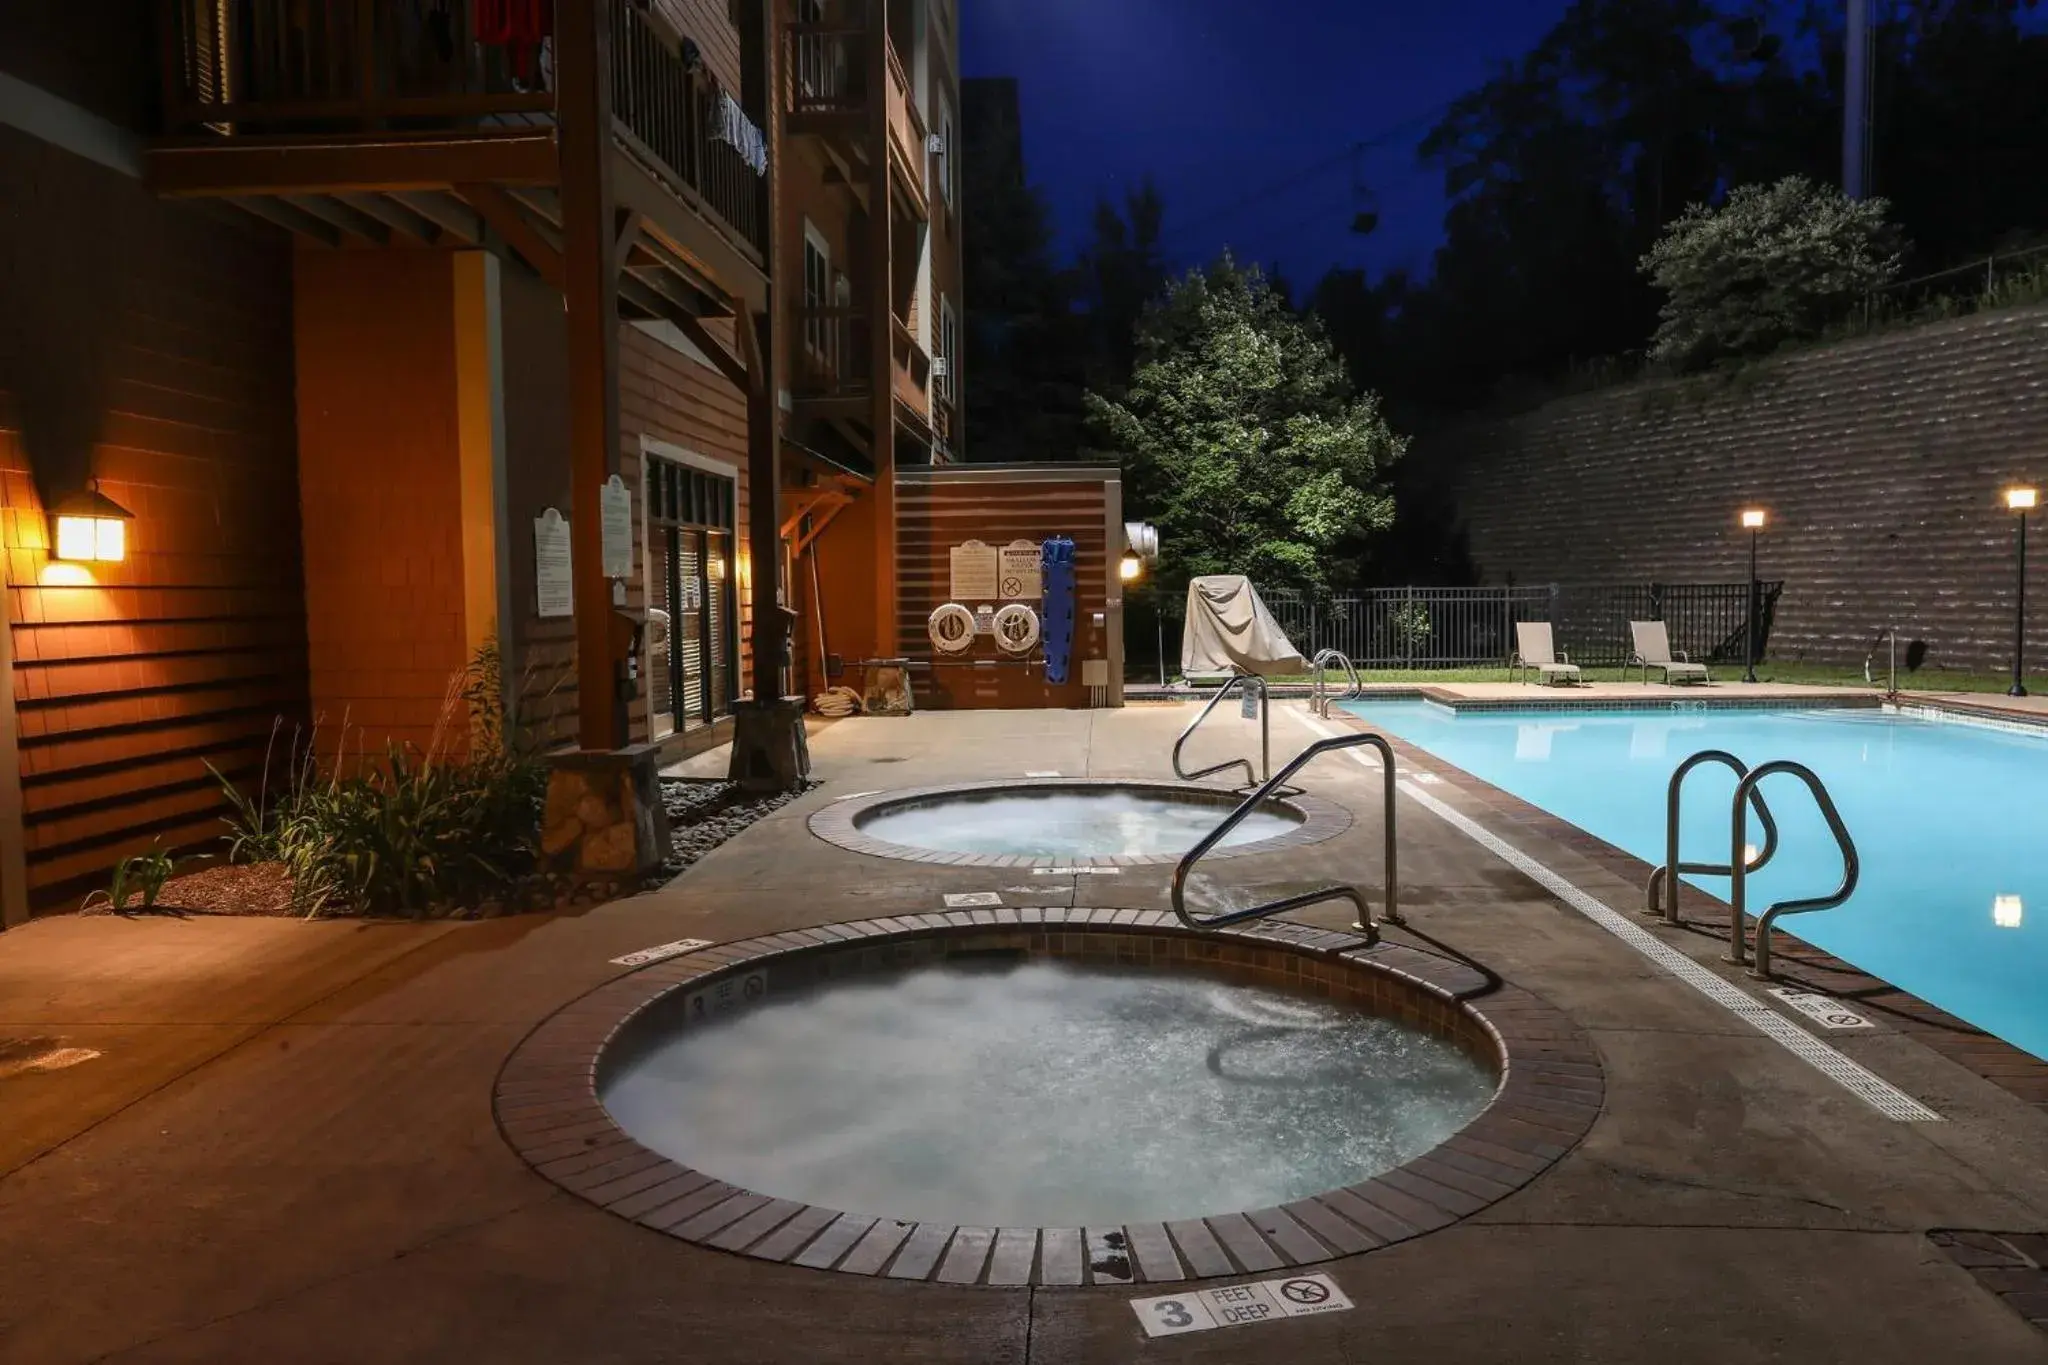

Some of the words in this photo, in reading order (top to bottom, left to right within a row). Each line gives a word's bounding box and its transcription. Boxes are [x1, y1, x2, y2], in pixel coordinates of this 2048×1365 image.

[1211, 1285, 1255, 1305] FEET
[1154, 1300, 1194, 1328] 3
[1221, 1304, 1270, 1323] DEEP
